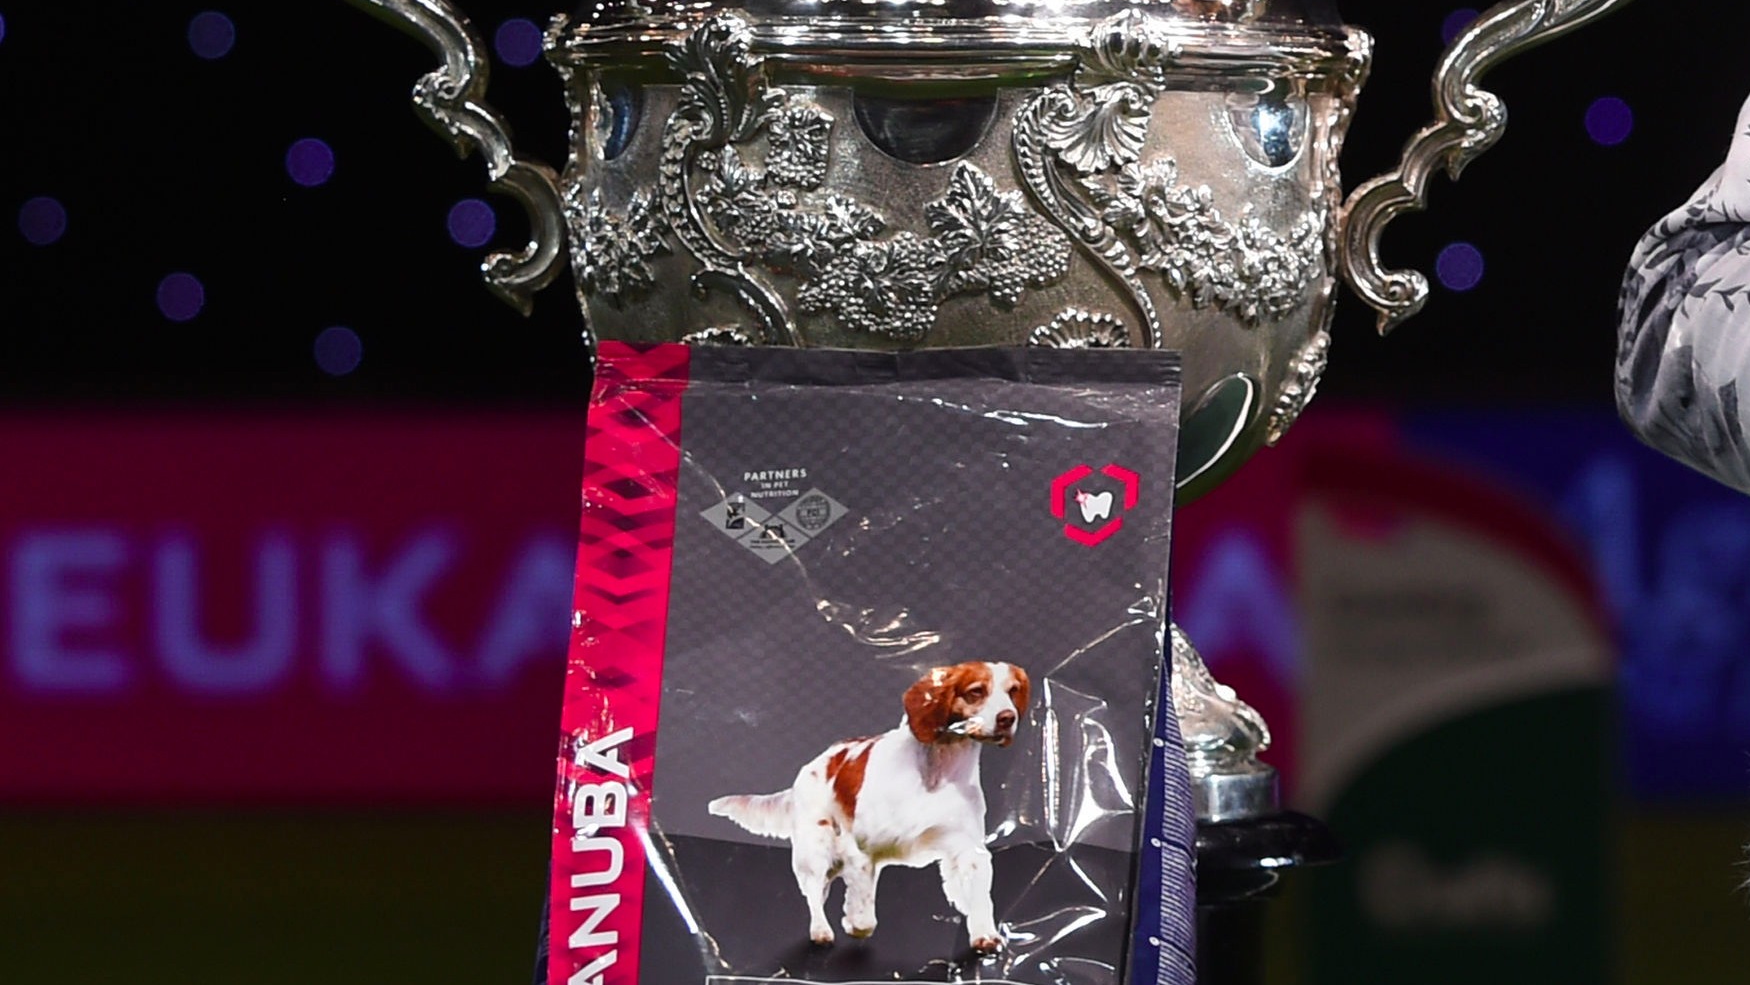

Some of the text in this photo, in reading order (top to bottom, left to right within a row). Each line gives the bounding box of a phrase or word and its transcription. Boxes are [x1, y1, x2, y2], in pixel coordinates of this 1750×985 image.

[743, 468, 808, 481] PARTNERS
[773, 480, 789, 488] PET
[750, 489, 800, 499] NUTRITION
